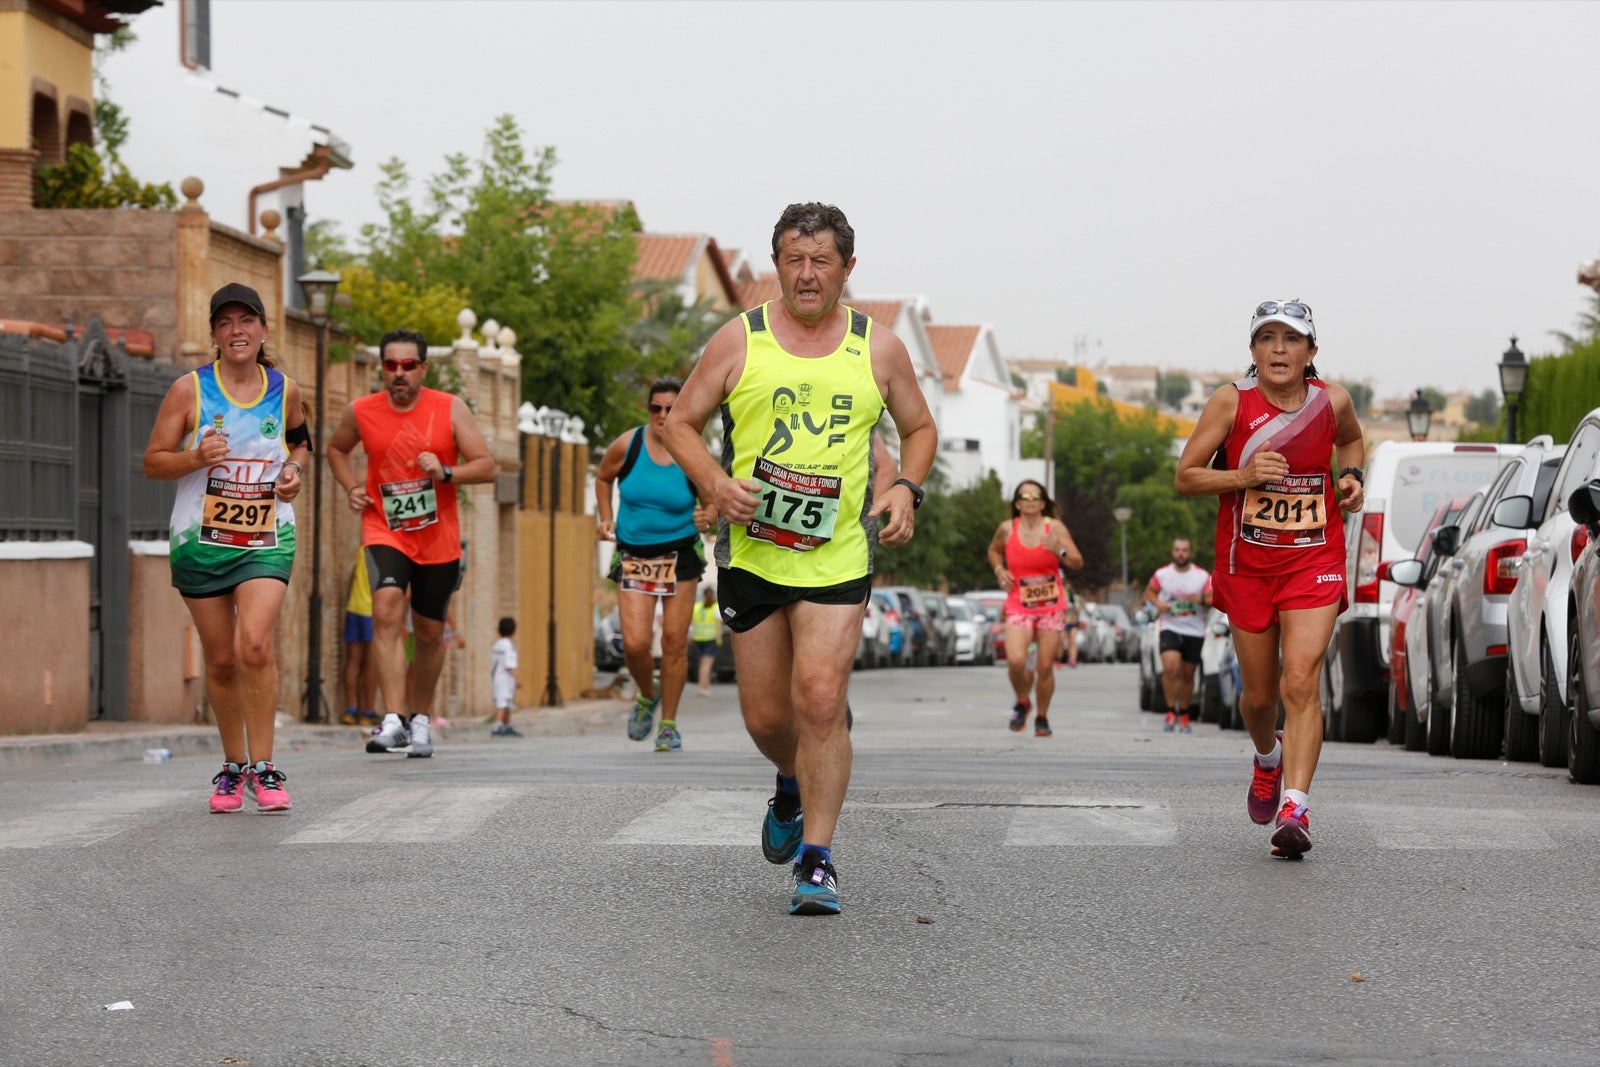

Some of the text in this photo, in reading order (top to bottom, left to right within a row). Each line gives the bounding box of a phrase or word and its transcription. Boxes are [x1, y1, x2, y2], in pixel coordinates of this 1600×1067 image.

[773, 466, 787, 478] GRAN
[788, 473, 810, 487] PREMIO
[811, 478, 818, 487] DE
[818, 478, 838, 489] FONDO
[1302, 478, 1308, 486] DE
[212, 502, 271, 526] 2297
[392, 494, 427, 516] 241
[763, 490, 824, 529] 175
[1255, 496, 1318, 523] 2011
[631, 563, 672, 579] 2077
[1026, 585, 1054, 598] 2067
